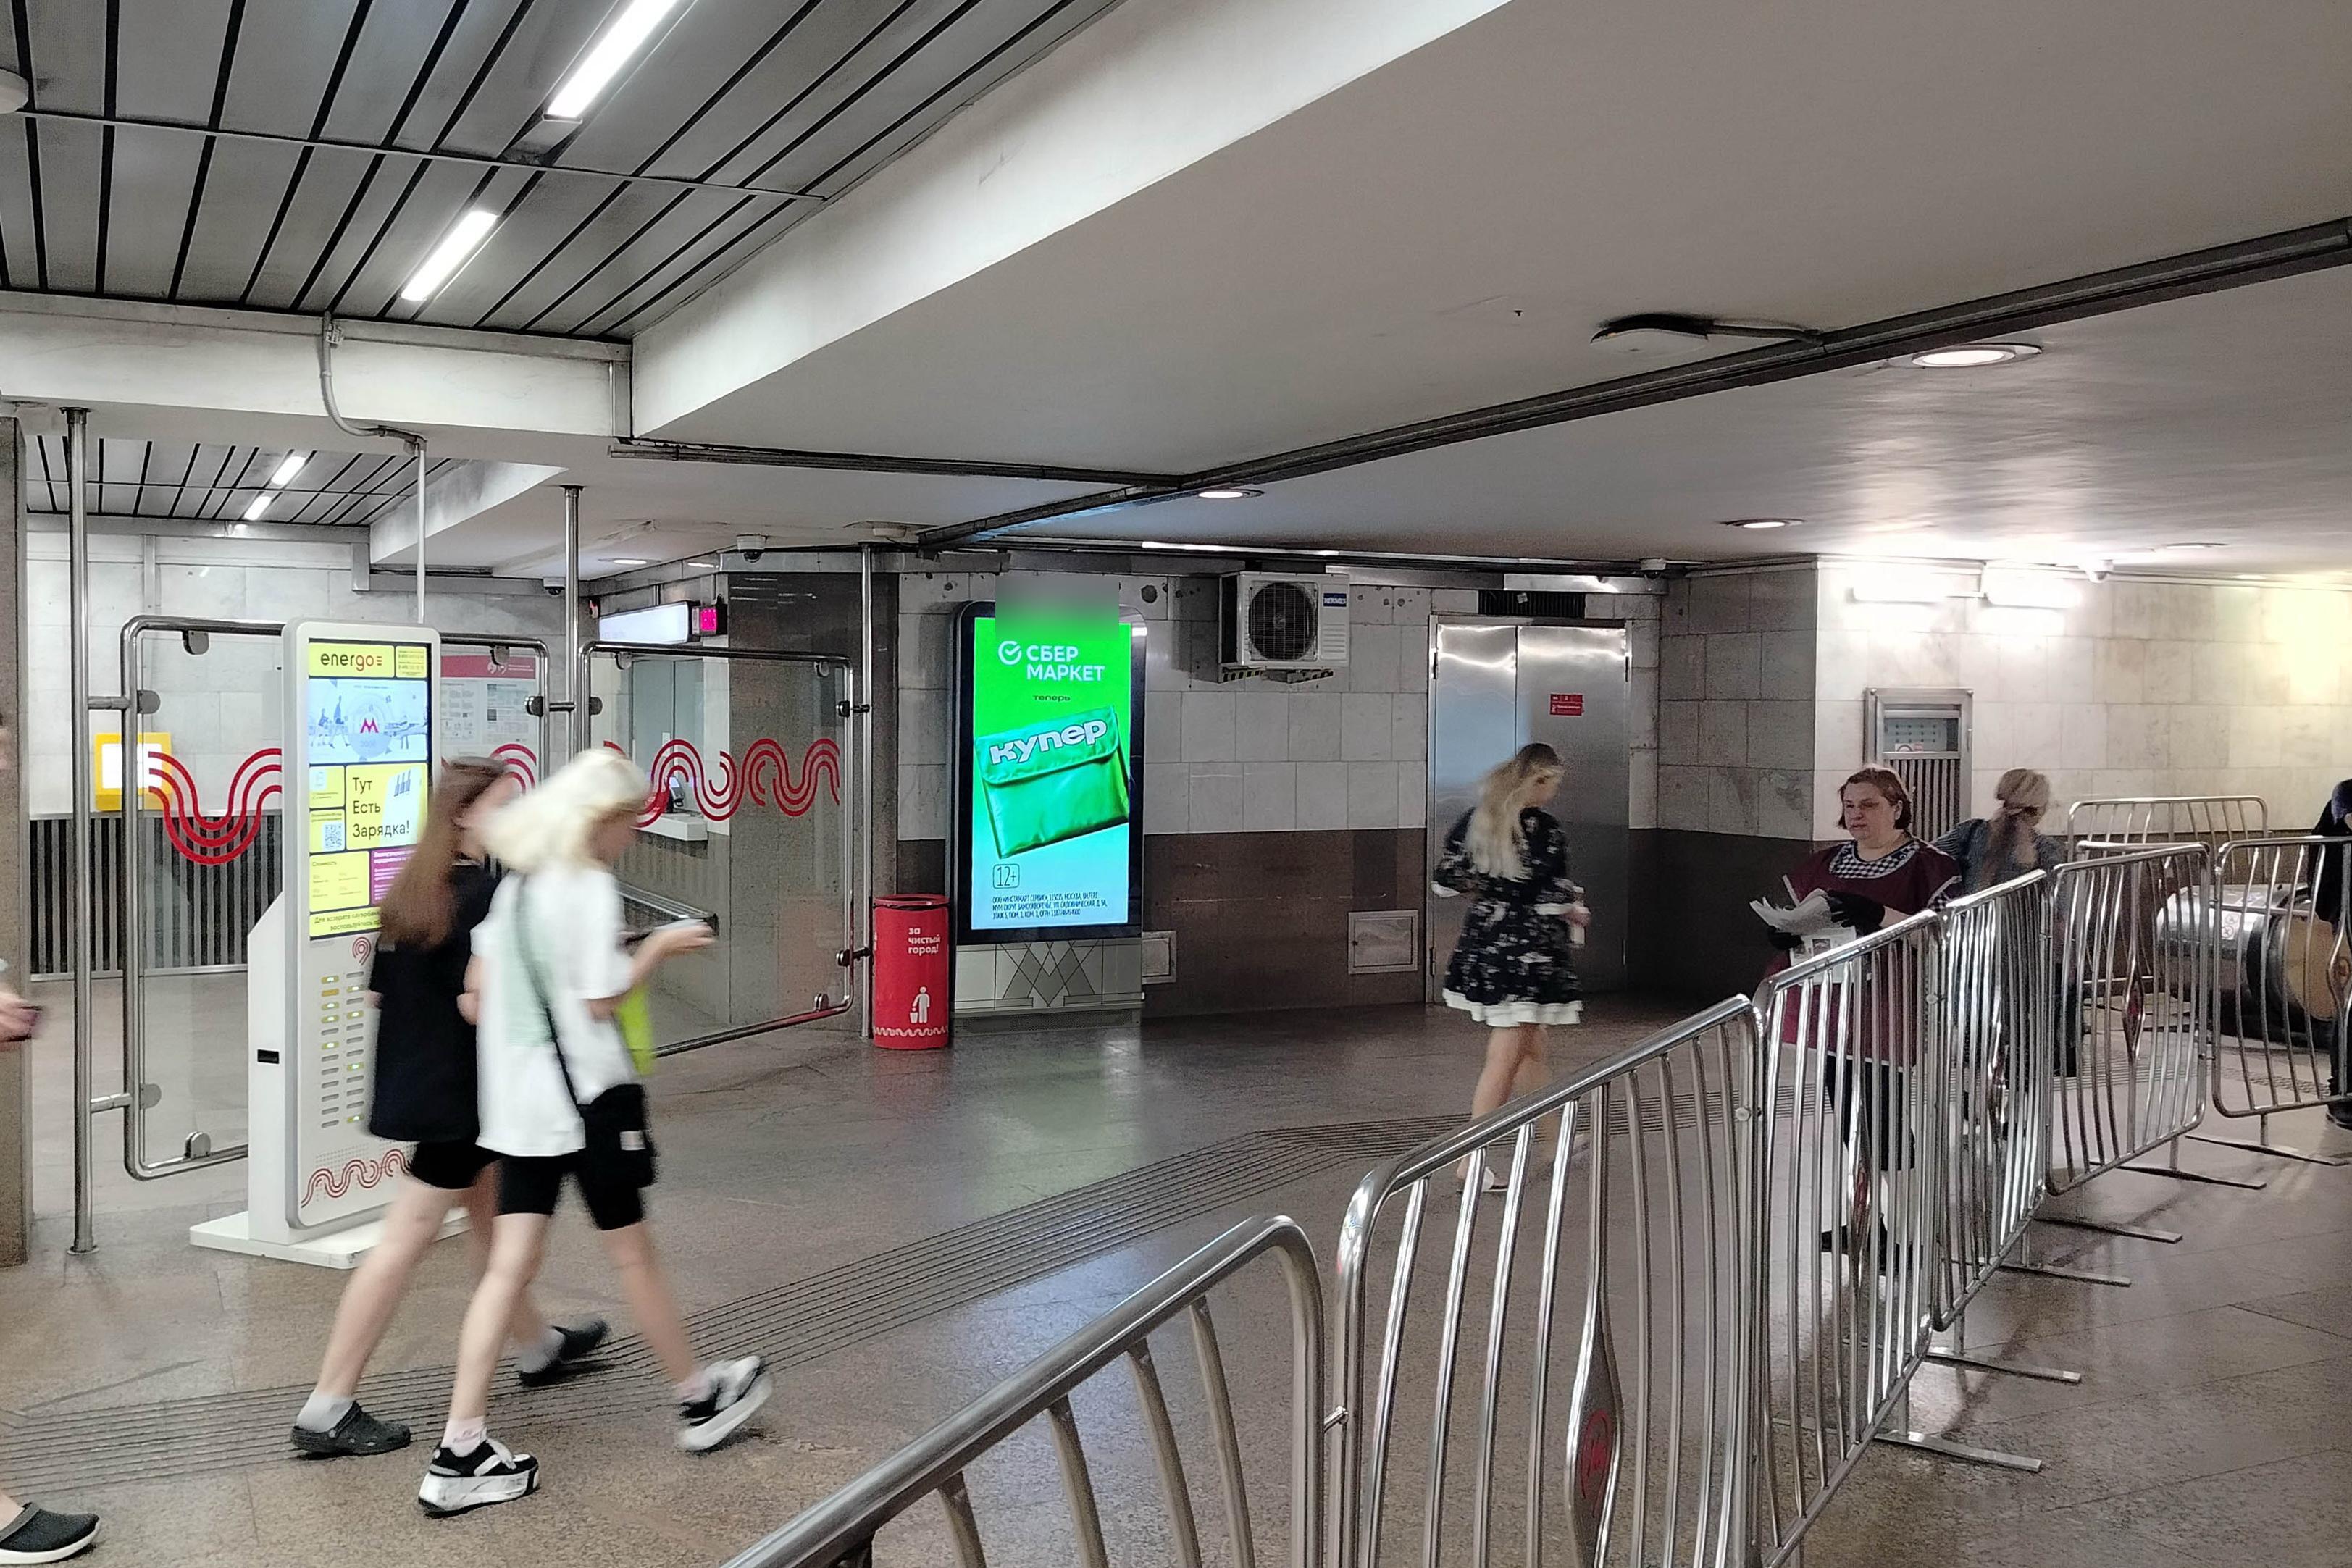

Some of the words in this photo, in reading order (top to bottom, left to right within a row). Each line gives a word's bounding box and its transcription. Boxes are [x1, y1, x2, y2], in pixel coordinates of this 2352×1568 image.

[320, 652, 374, 671] energo
[1026, 645, 1079, 663] СБЕР
[1026, 664, 1105, 682] МАРКЕТ
[989, 718, 1108, 766] купер
[353, 776, 372, 795] Тут
[353, 799, 381, 815] Есть
[352, 819, 410, 840] Зарядка!
[997, 865, 1016, 886] 12+
[908, 934, 940, 944] чистый
[908, 944, 939, 957] город!
